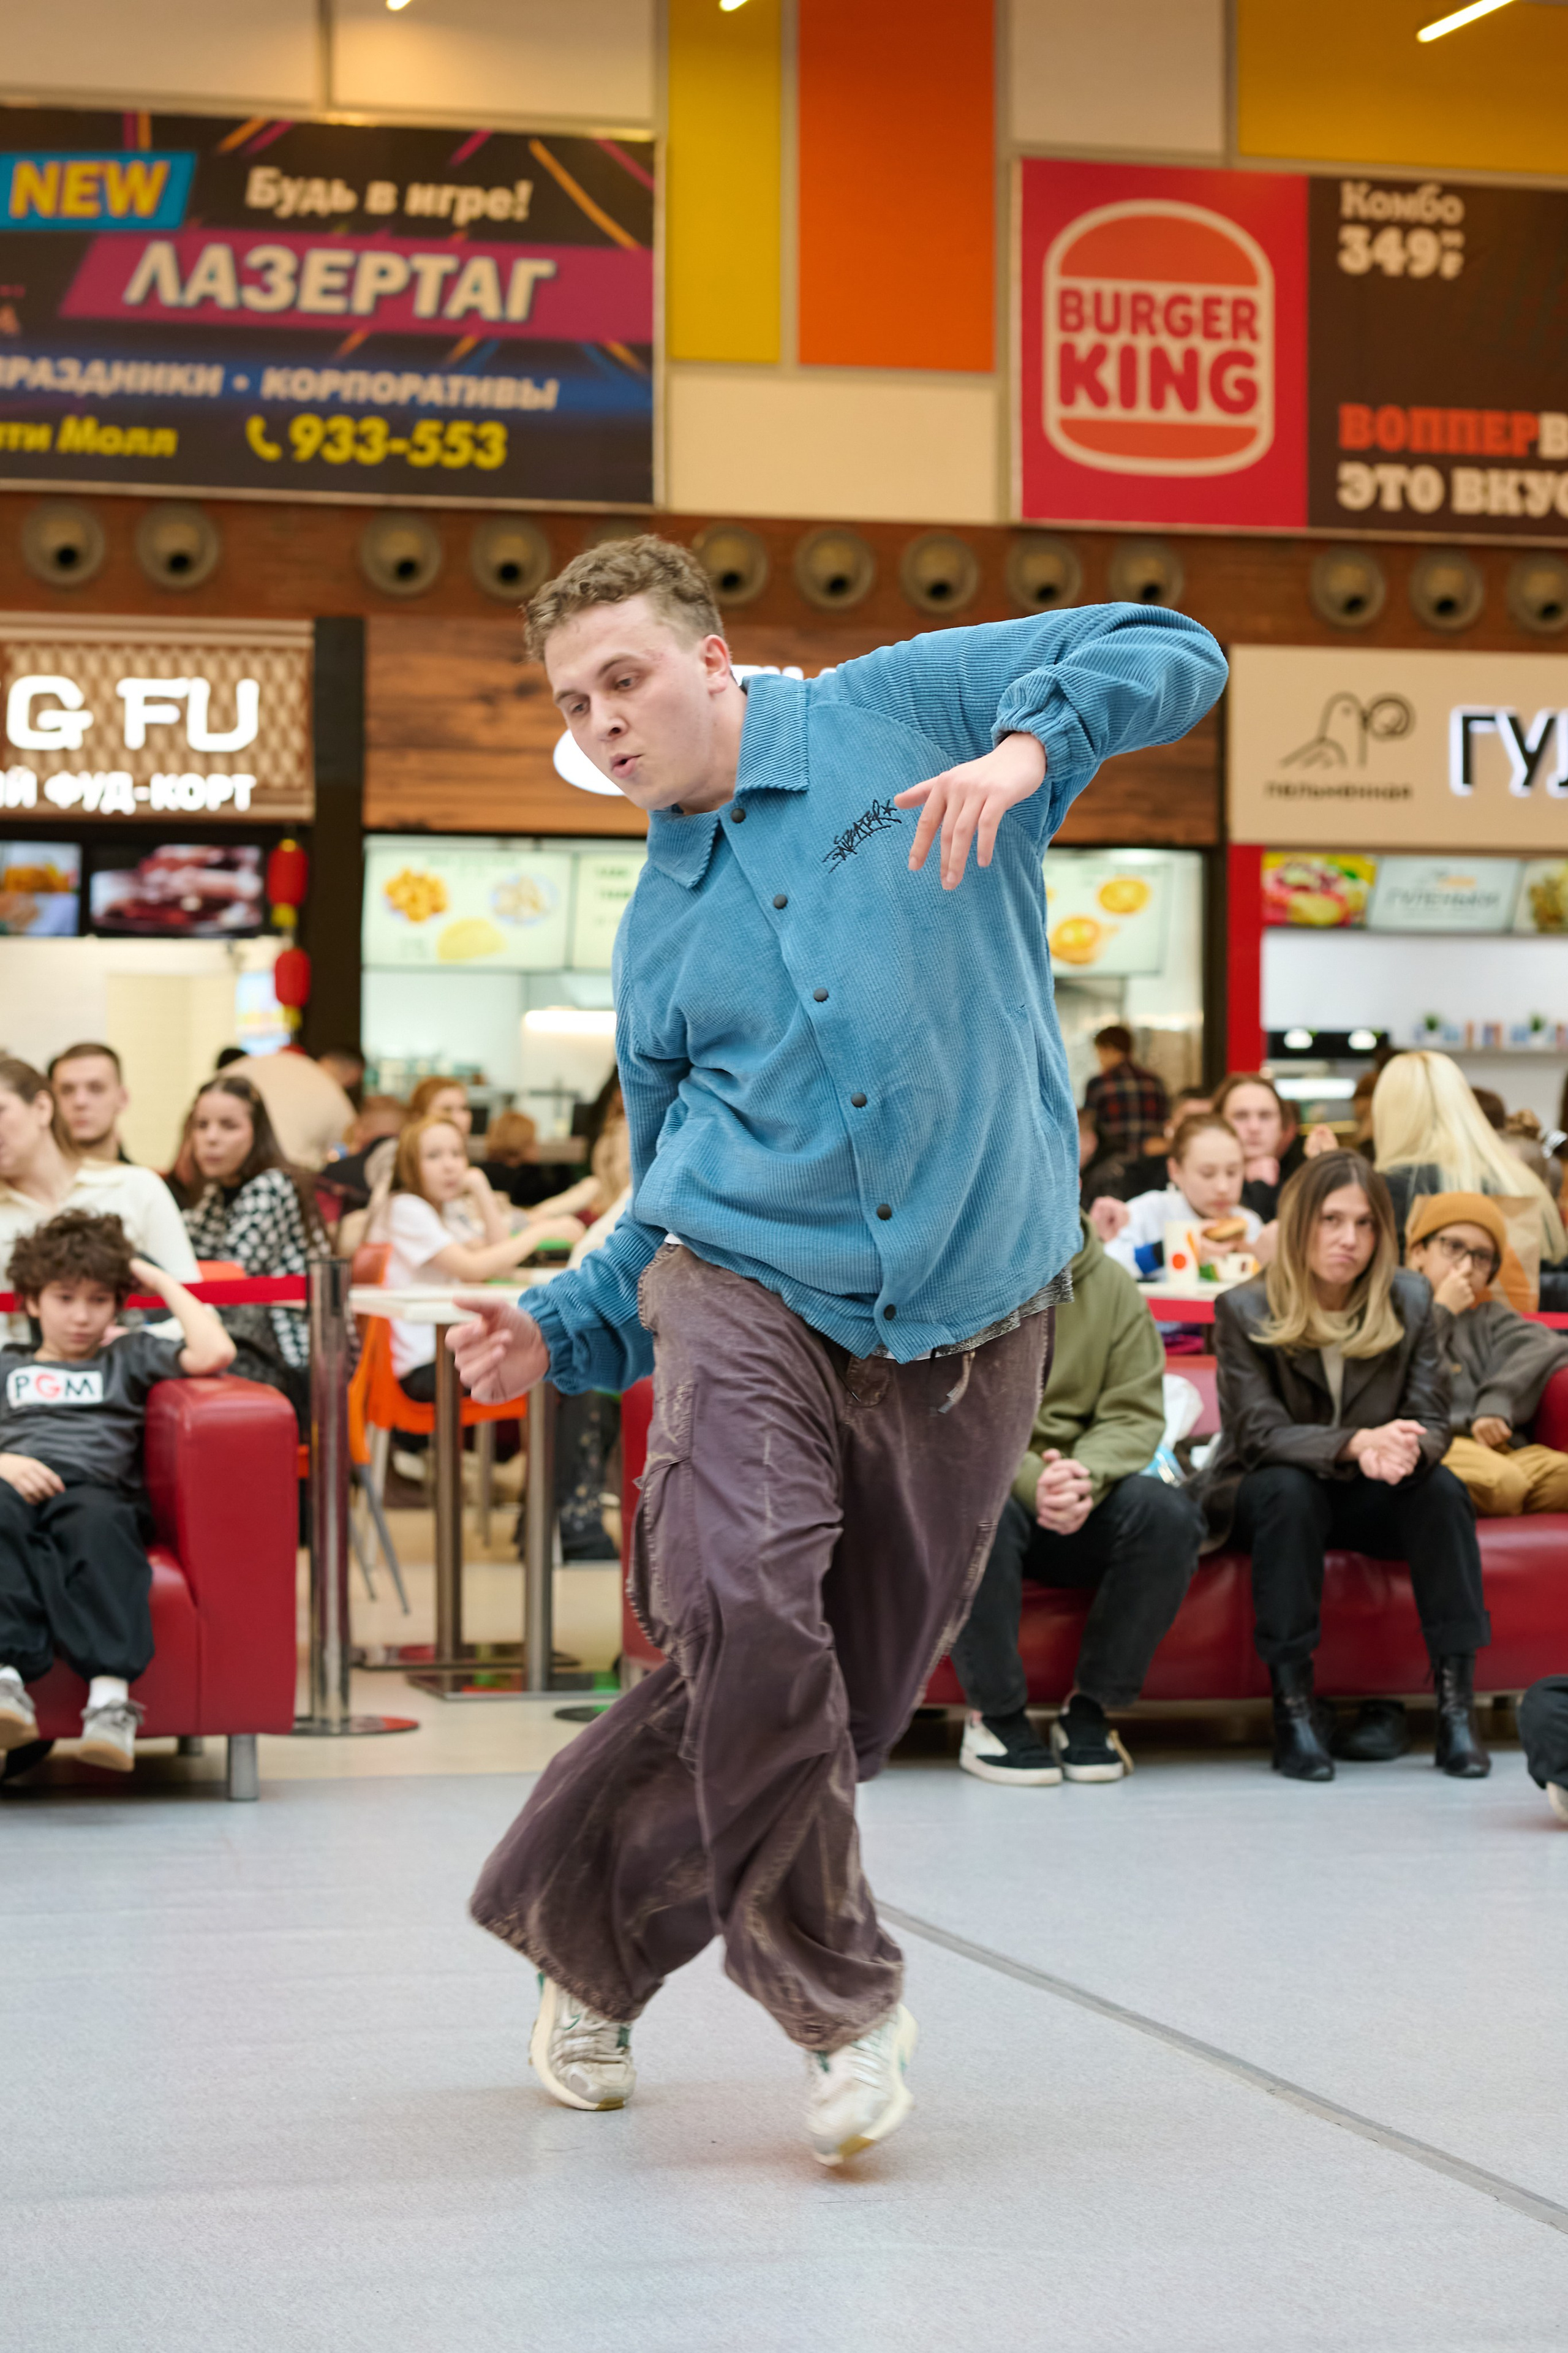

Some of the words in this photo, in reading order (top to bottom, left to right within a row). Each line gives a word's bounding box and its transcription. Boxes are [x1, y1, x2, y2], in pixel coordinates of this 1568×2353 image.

[9, 161, 170, 219] NEW
[247, 165, 358, 219] Будь
[364, 180, 397, 215] в
[404, 180, 533, 227] игре!
[1340, 180, 1464, 225] Комбо
[124, 241, 556, 323] ЛАЗЕРТАГ
[1058, 289, 1259, 342] BURGER
[260, 367, 560, 410] КОРПОРАТИВЫ
[1058, 342, 1259, 414] KING
[57, 415, 178, 458] Молл
[288, 413, 509, 470] 933-553
[1337, 461, 1445, 513] ЭТО
[116, 677, 259, 752] FU
[15, 1374, 95, 1400] PGM
